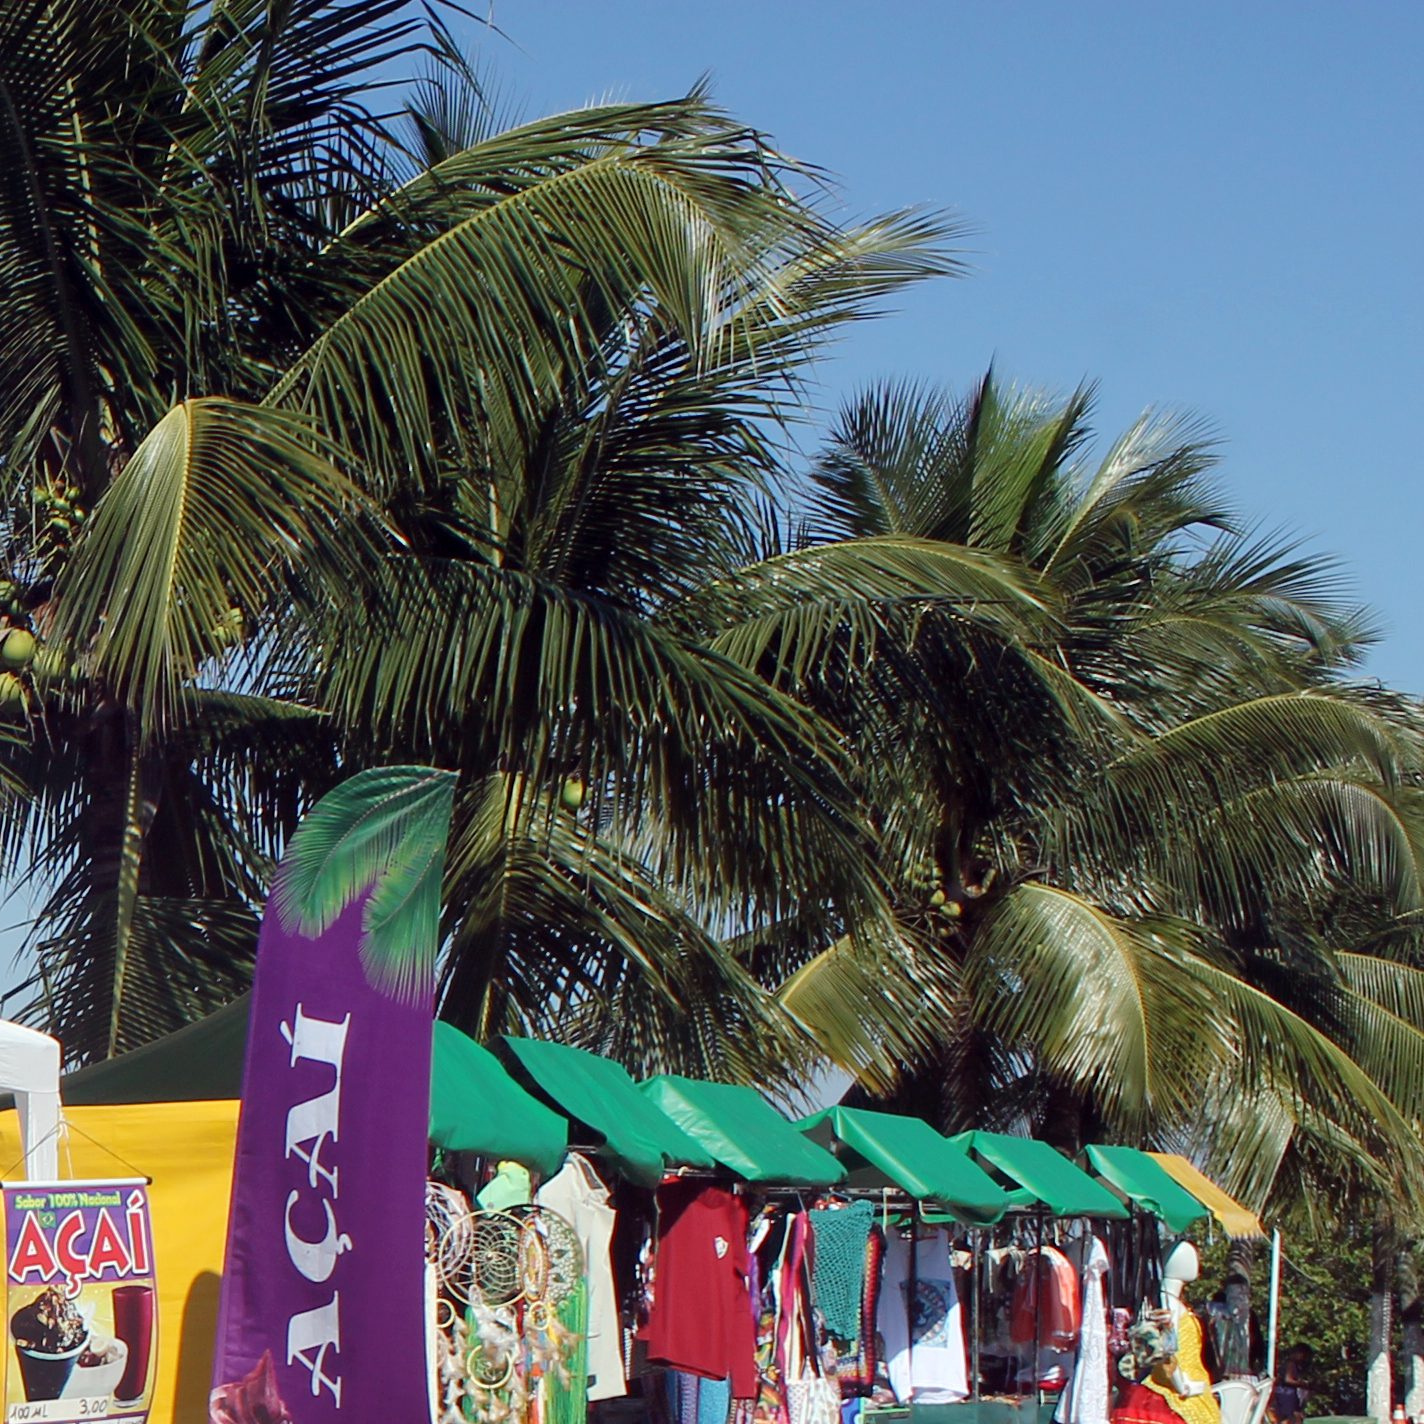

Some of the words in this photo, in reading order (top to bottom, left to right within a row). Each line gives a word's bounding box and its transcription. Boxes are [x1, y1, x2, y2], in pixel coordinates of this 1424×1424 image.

[9, 1189, 150, 1300] AÇAÍ
[15, 1194, 46, 1209] Sabor
[48, 1192, 78, 1208] 100%
[79, 1190, 121, 1207] Nacional
[280, 1001, 353, 1410] AÇAÍ
